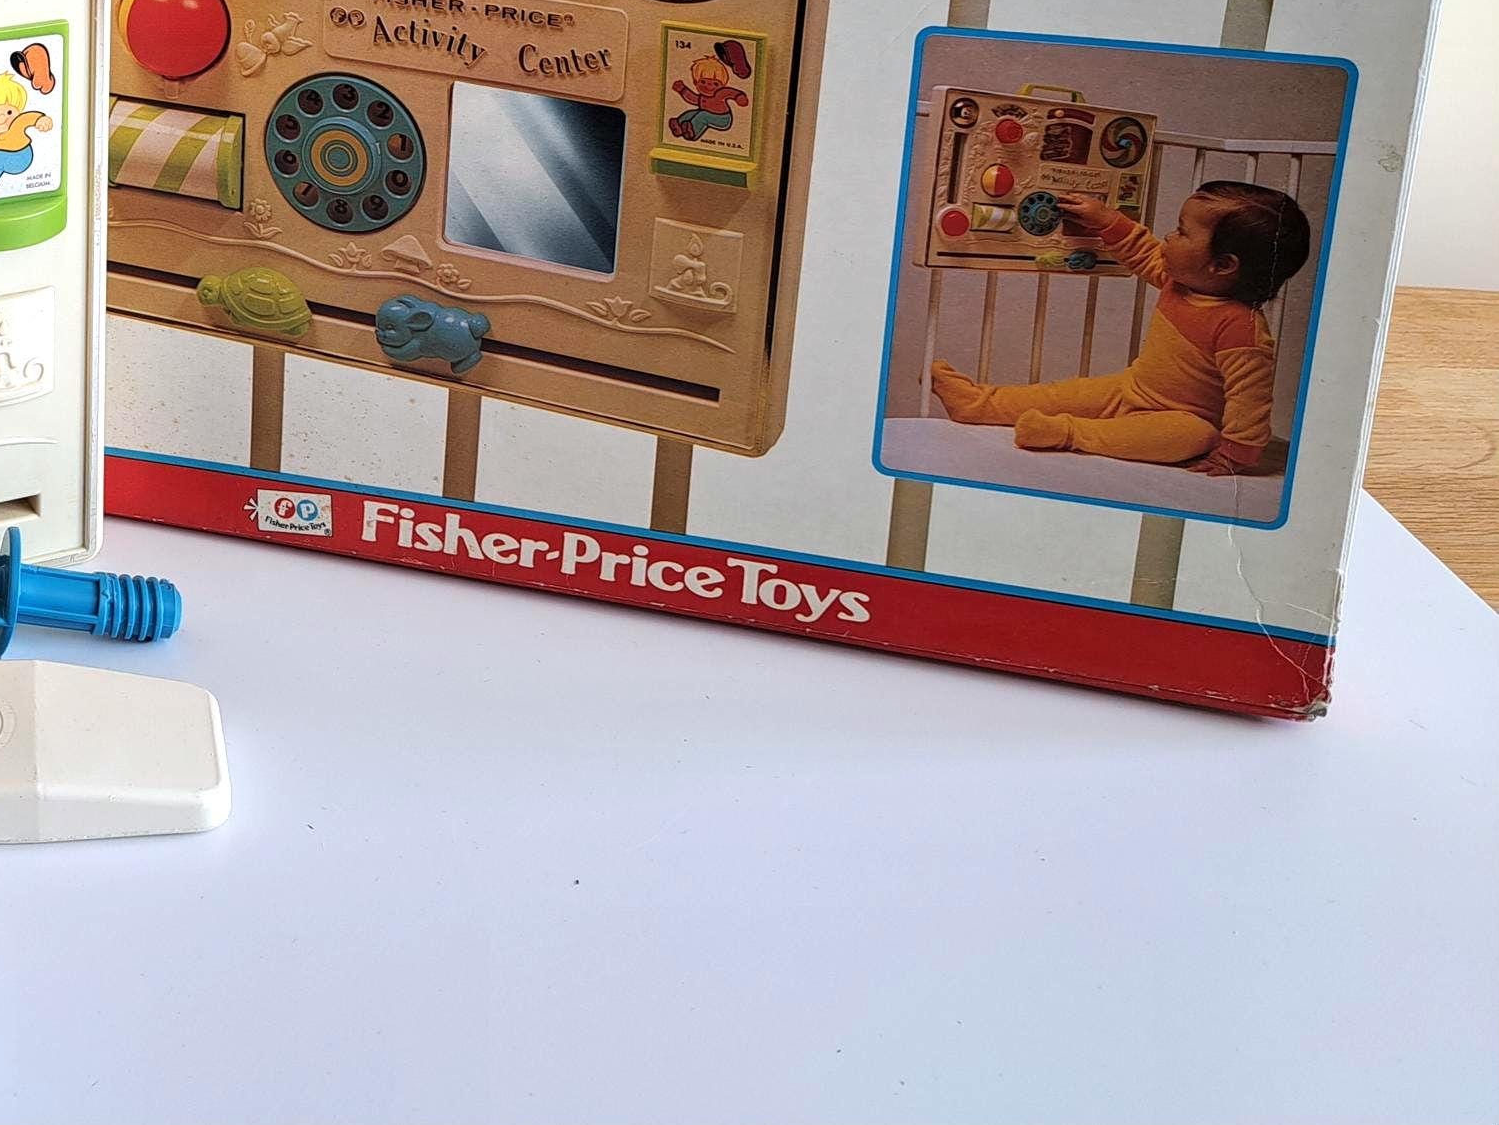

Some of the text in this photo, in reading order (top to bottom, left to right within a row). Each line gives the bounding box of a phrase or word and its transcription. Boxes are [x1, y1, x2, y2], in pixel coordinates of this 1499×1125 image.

[372, 15, 612, 75] Activity Center
[675, 40, 691, 50] 134
[361, 499, 871, 623] Fisher-Price Toys
